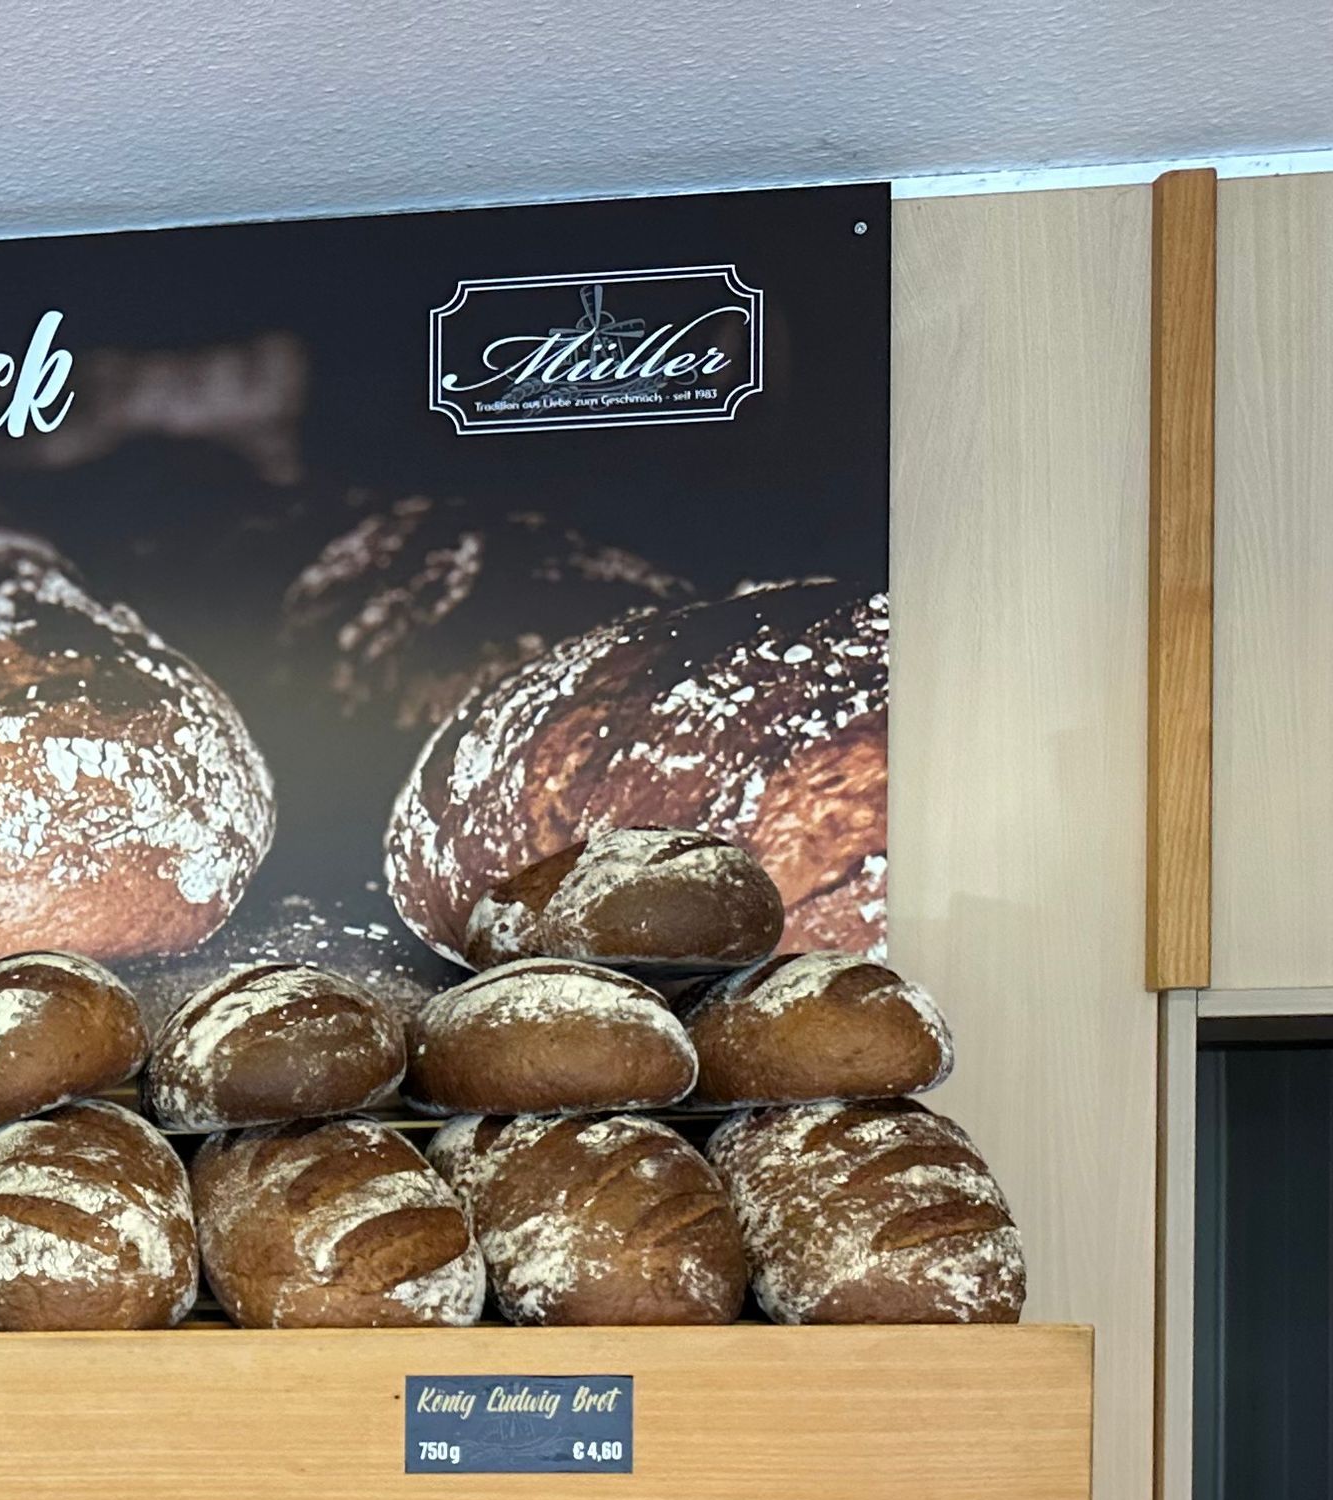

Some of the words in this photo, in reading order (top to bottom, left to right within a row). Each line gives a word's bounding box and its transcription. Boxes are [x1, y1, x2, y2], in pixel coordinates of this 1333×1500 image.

[442, 305, 750, 391] Müller
[417, 1387, 476, 1420] König
[486, 1386, 561, 1420] Ludwig
[571, 1386, 622, 1413] Brot
